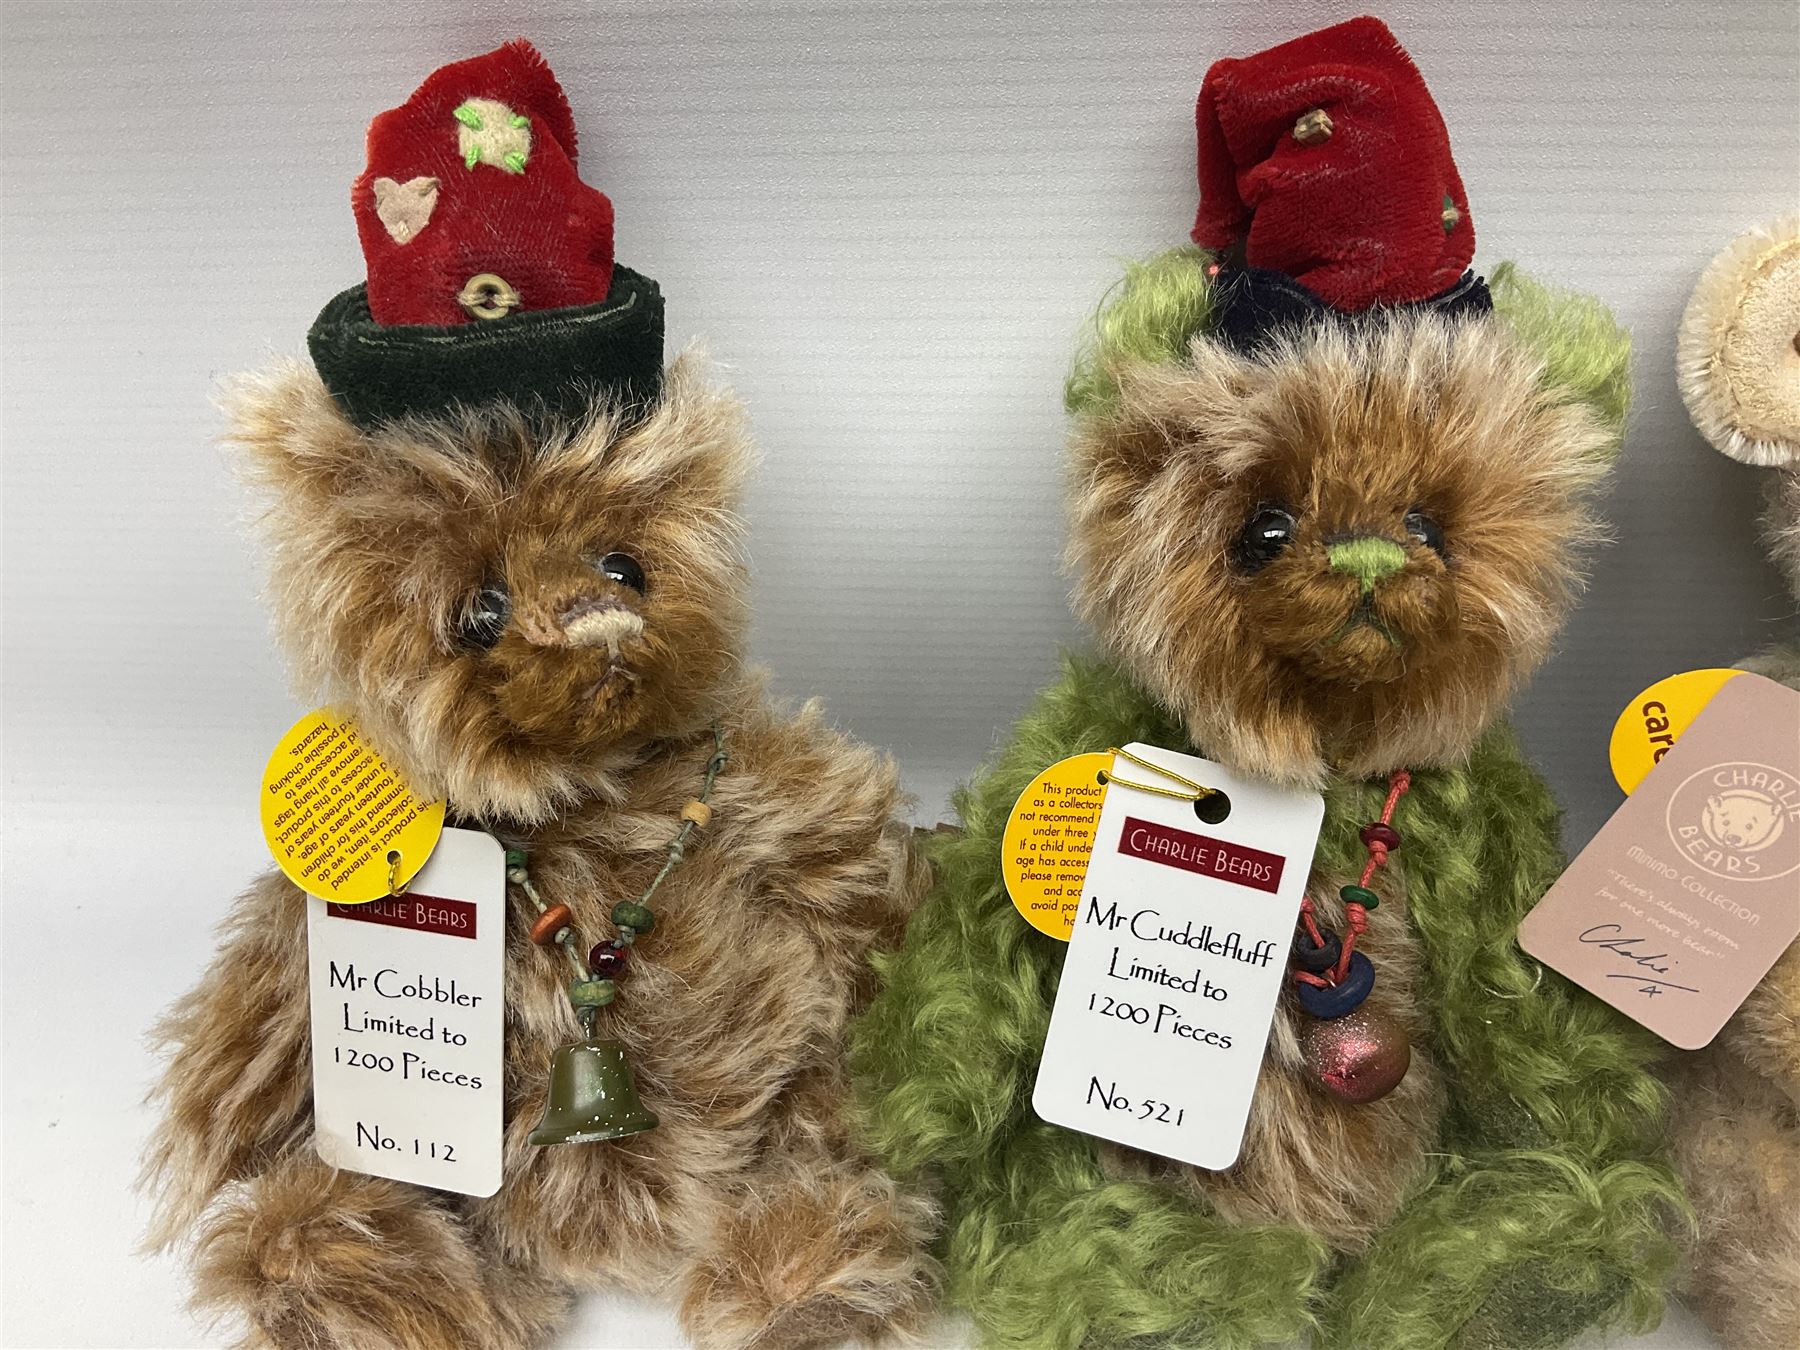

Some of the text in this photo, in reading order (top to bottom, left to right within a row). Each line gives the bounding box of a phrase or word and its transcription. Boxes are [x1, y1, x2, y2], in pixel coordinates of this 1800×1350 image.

[289, 721, 329, 755] hazards.
[269, 727, 339, 794] possible choking
[295, 740, 347, 790] accessories
[329, 745, 363, 777] remove
[340, 755, 373, 785] access
[284, 788, 296, 799] to
[317, 775, 329, 790] all
[330, 784, 341, 795] to
[354, 768, 380, 793] under
[354, 775, 393, 810] fourteen
[1043, 782, 1102, 797] This product
[293, 786, 319, 809] hang
[312, 794, 331, 811] this
[318, 791, 355, 824] fourteen
[1033, 799, 1044, 807] as
[1059, 797, 1103, 809] collectors
[273, 808, 295, 827] tags
[275, 807, 313, 843] product,
[329, 807, 355, 833] years
[348, 817, 367, 834] this
[379, 808, 417, 845] product
[1020, 812, 1036, 820] not
[1039, 812, 1094, 823] recommend
[1033, 824, 1060, 836] under
[1065, 825, 1088, 837] three
[294, 820, 319, 846] years
[317, 794, 412, 881] collectors item, we do
[318, 832, 328, 846] of
[336, 832, 350, 847] for
[1020, 838, 1027, 850] If
[1040, 839, 1064, 852] child
[284, 844, 294, 857] of
[297, 841, 318, 859] age.
[370, 842, 382, 852] is
[1130, 829, 1272, 881] CHARLIE BEARS
[1678, 826, 1760, 873] BEARS
[301, 845, 335, 877] children
[330, 850, 371, 890] intended
[1016, 857, 1034, 868] age
[1039, 854, 1055, 866] has
[1021, 868, 1052, 882] please
[1044, 884, 1063, 896] and
[416, 902, 467, 928] BEARS
[1031, 899, 1058, 910] avoid
[1086, 896, 1276, 967] Mr Cuddlefluff
[330, 961, 482, 1008] Mr Cobbler
[1107, 947, 1228, 1001] Limited to
[343, 1003, 467, 1046] Limited to
[1088, 993, 1232, 1049] 1200 Pieces
[335, 1046, 483, 1090] 1200 Pieces
[1086, 1076, 1184, 1126] No. 521
[356, 1121, 457, 1162] No. 112
